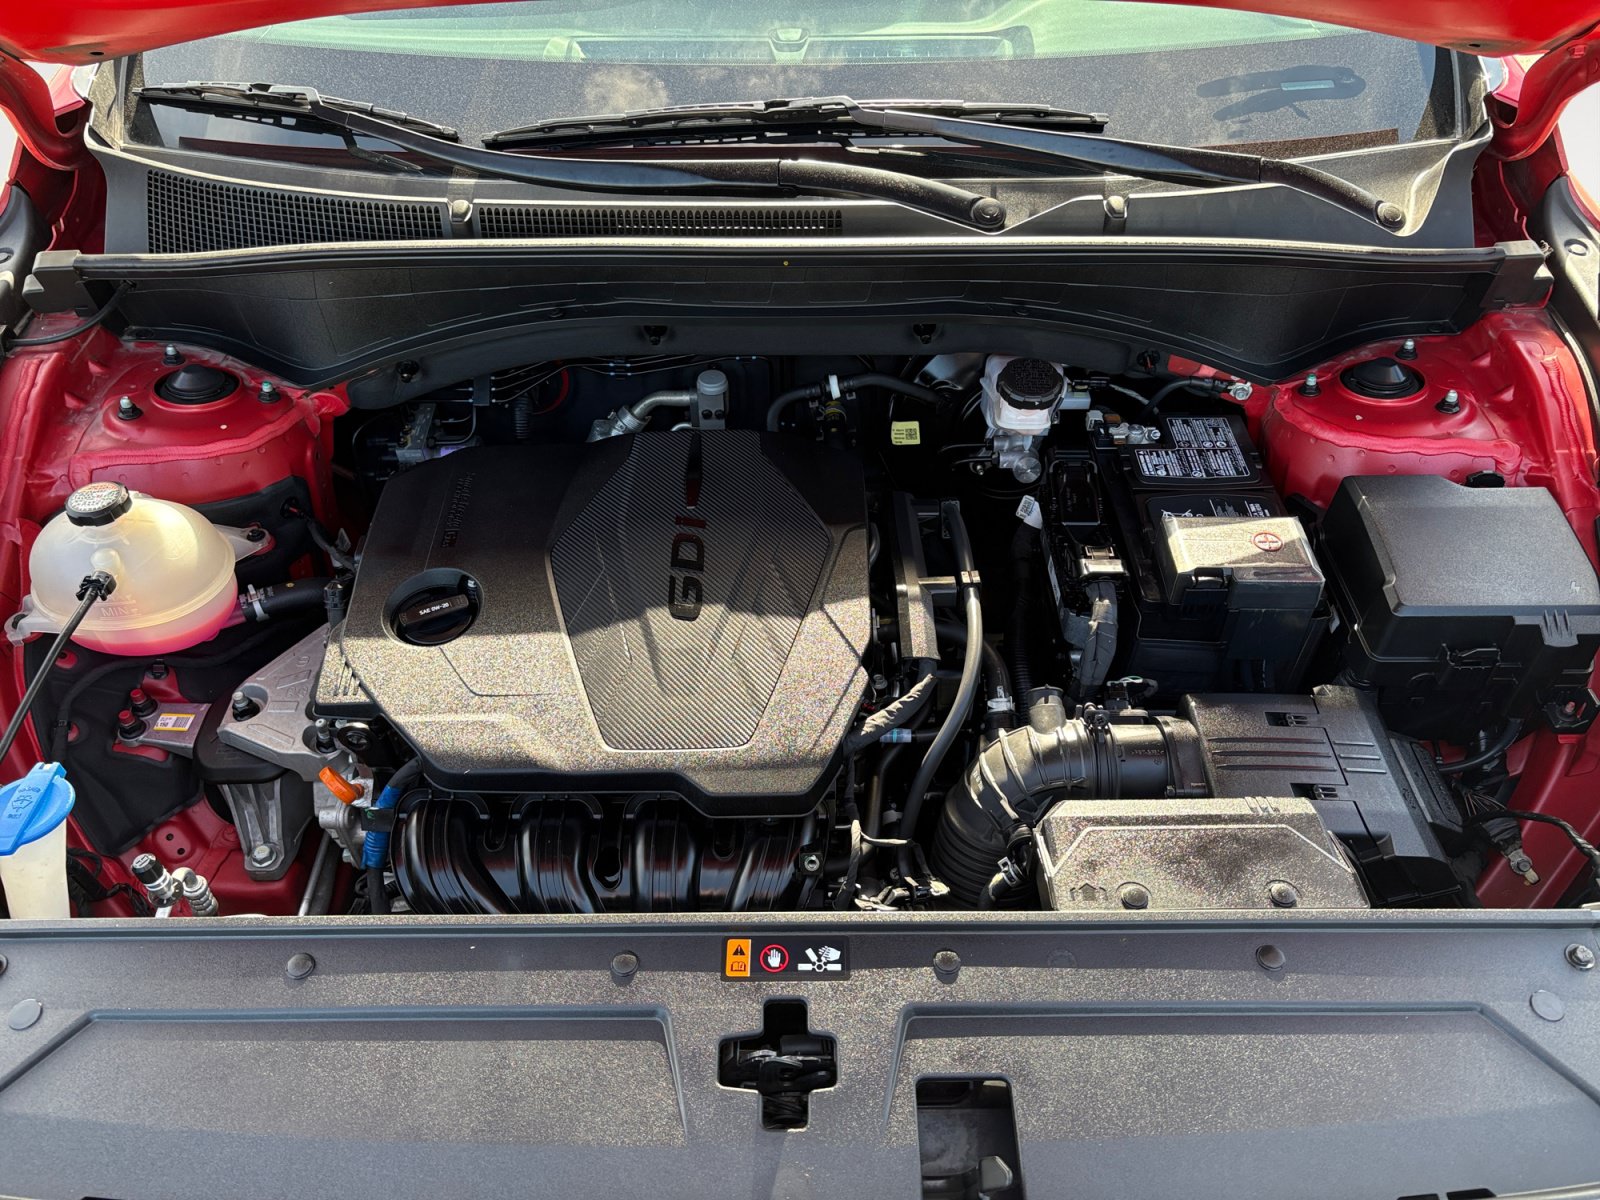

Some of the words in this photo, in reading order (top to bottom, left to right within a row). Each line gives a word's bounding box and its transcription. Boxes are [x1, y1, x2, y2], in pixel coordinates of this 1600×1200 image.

[100, 606, 128, 617] MIN
[419, 607, 431, 615] SAE
[431, 602, 450, 611] 0W-20
